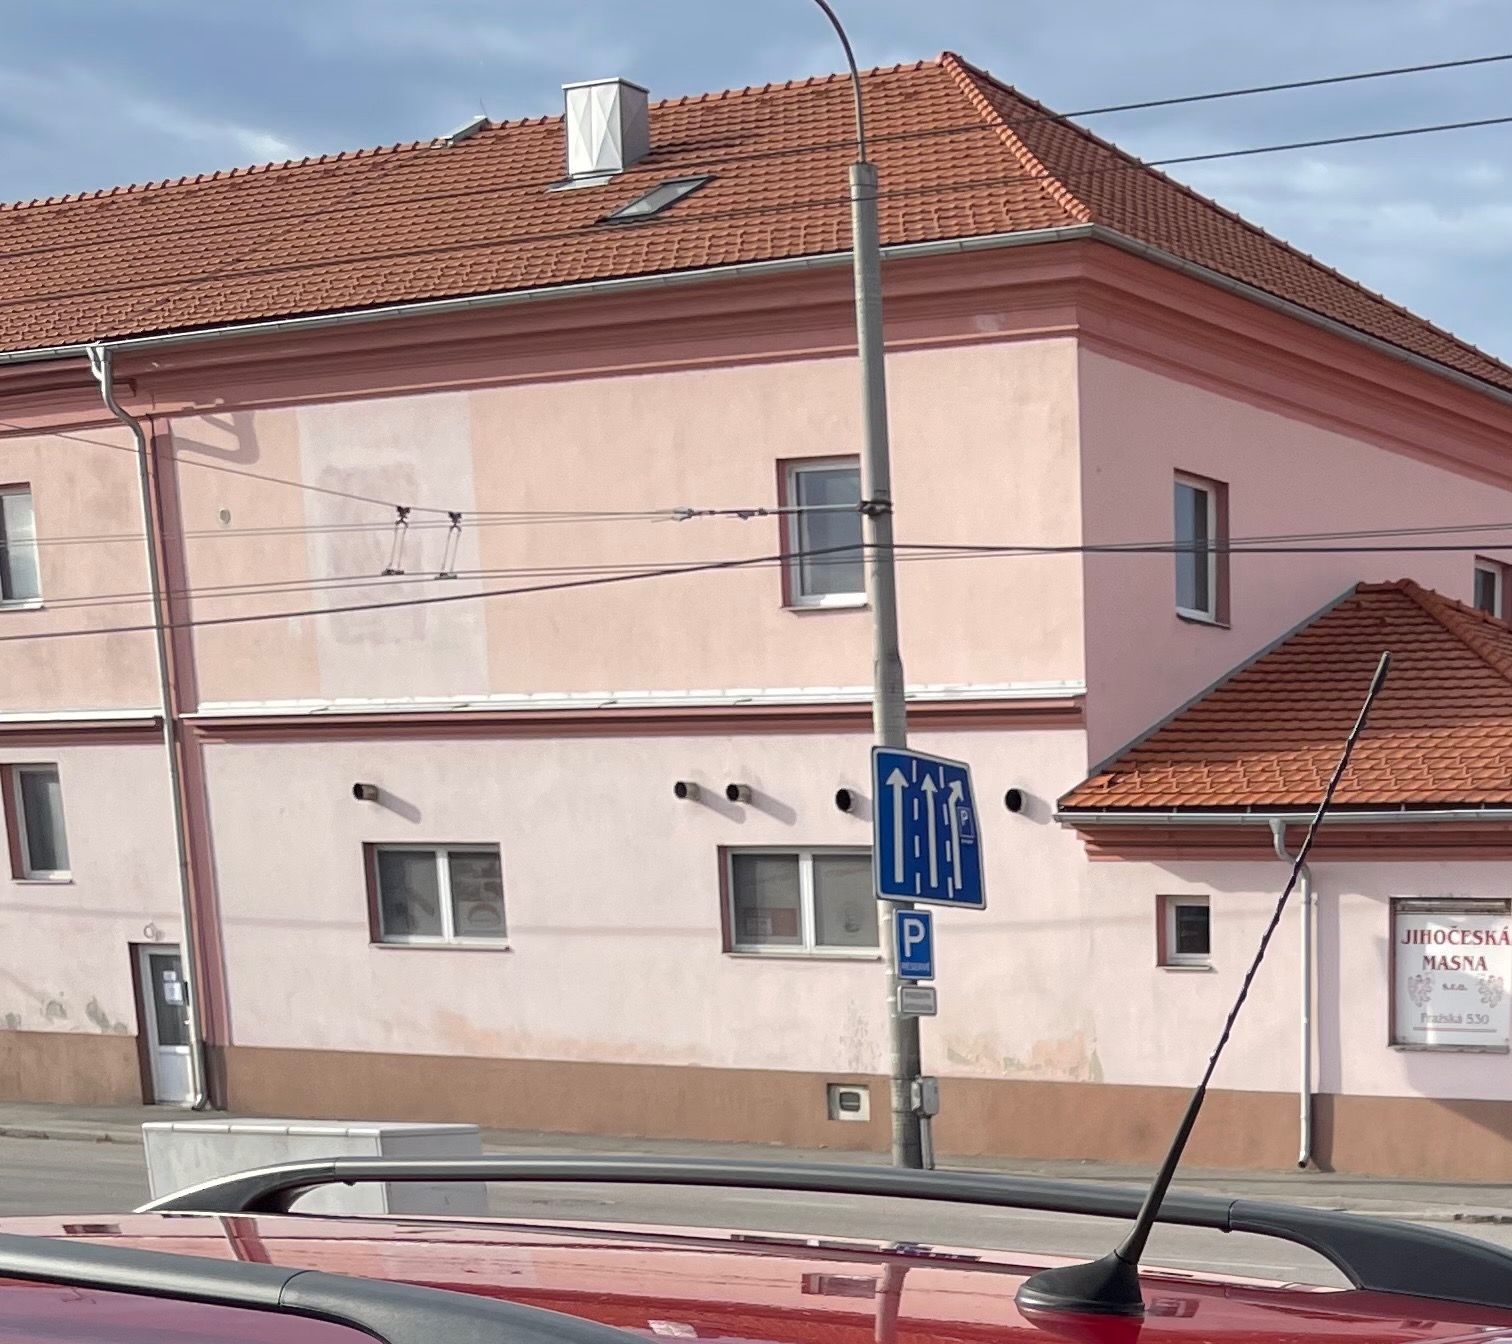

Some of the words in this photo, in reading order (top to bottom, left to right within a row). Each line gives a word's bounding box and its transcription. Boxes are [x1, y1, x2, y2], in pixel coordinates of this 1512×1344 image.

[903, 918, 926, 957] P
[1401, 925, 1512, 946] JIHOČESKÁ
[1422, 955, 1489, 972] MASNA
[1465, 1013, 1490, 1025] 530
